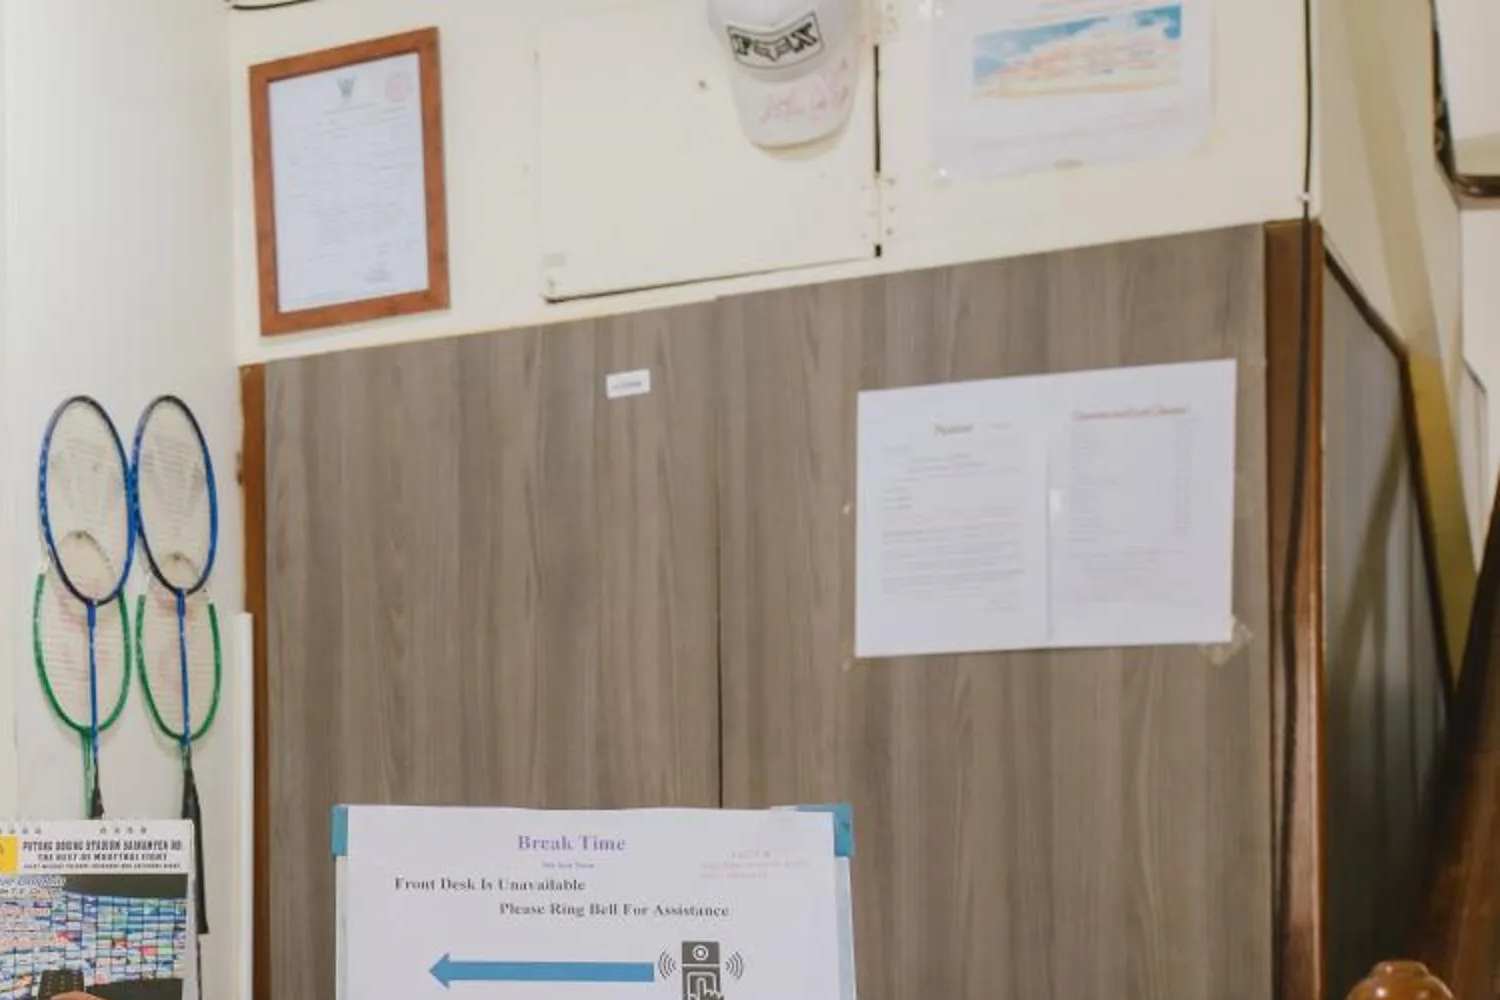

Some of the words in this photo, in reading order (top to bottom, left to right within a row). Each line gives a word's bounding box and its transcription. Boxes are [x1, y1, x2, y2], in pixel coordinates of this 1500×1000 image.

[518, 834, 574, 851] Break
[578, 834, 626, 851] Time
[394, 877, 435, 891] Front
[440, 877, 475, 891] Desk
[480, 877, 494, 891] Is
[498, 877, 587, 891] Unavailable
[499, 902, 545, 916] Please
[550, 902, 585, 918] Ring
[590, 903, 617, 916] Bell
[623, 903, 648, 916] For
[653, 904, 730, 918] Assistance
